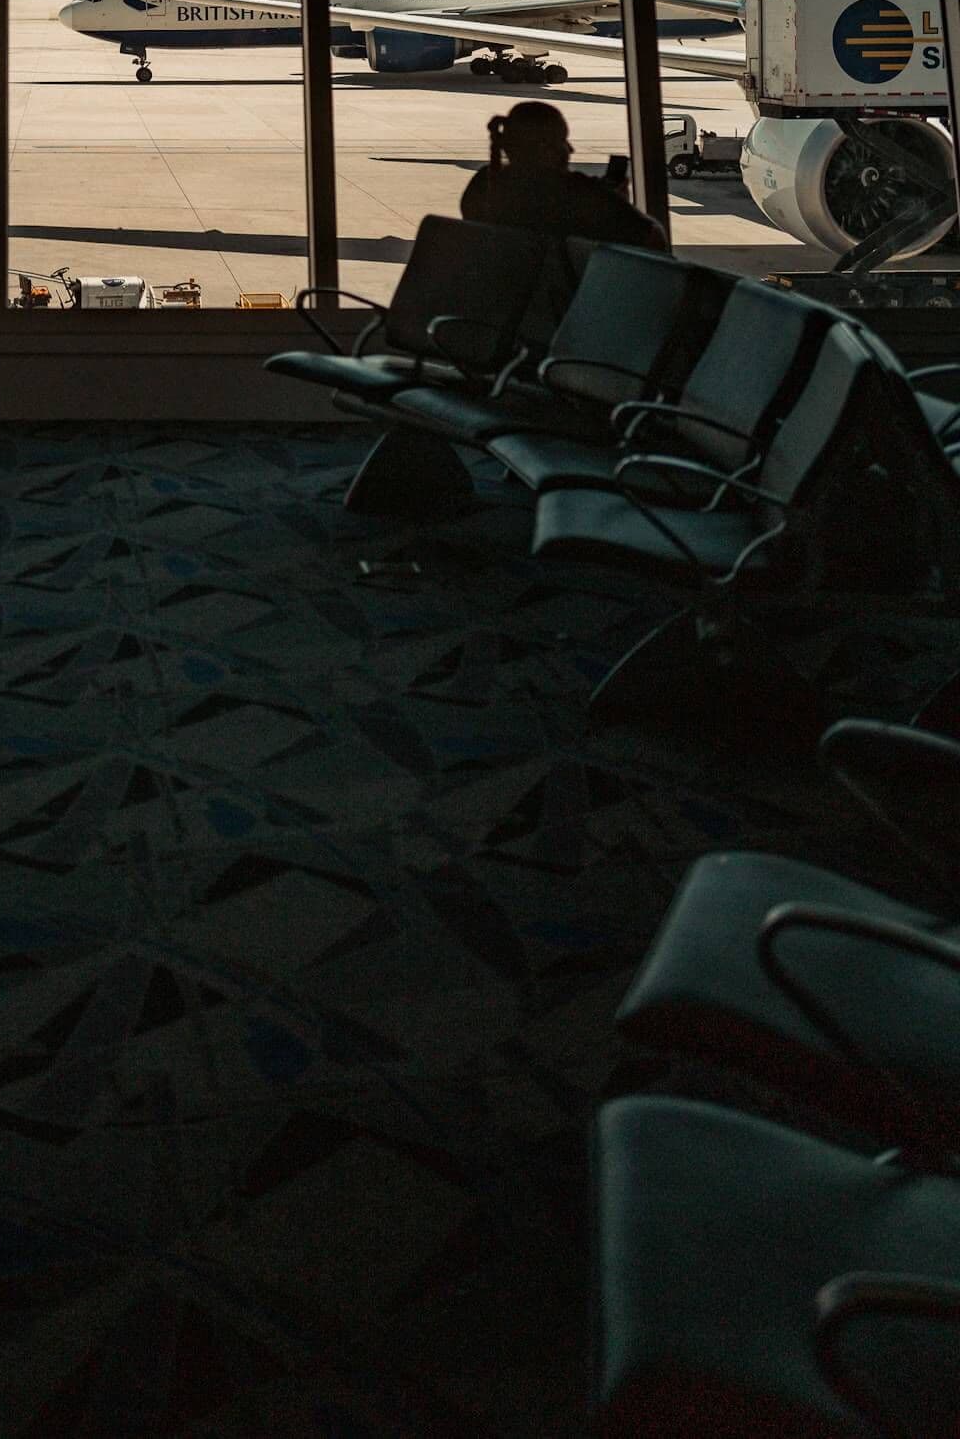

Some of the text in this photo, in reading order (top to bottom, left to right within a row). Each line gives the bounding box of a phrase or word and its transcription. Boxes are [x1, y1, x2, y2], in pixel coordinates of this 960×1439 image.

[177, 6, 254, 21] BRITISH
[922, 10, 939, 34] L
[922, 46, 945, 69] S
[96, 295, 124, 307] TUG
